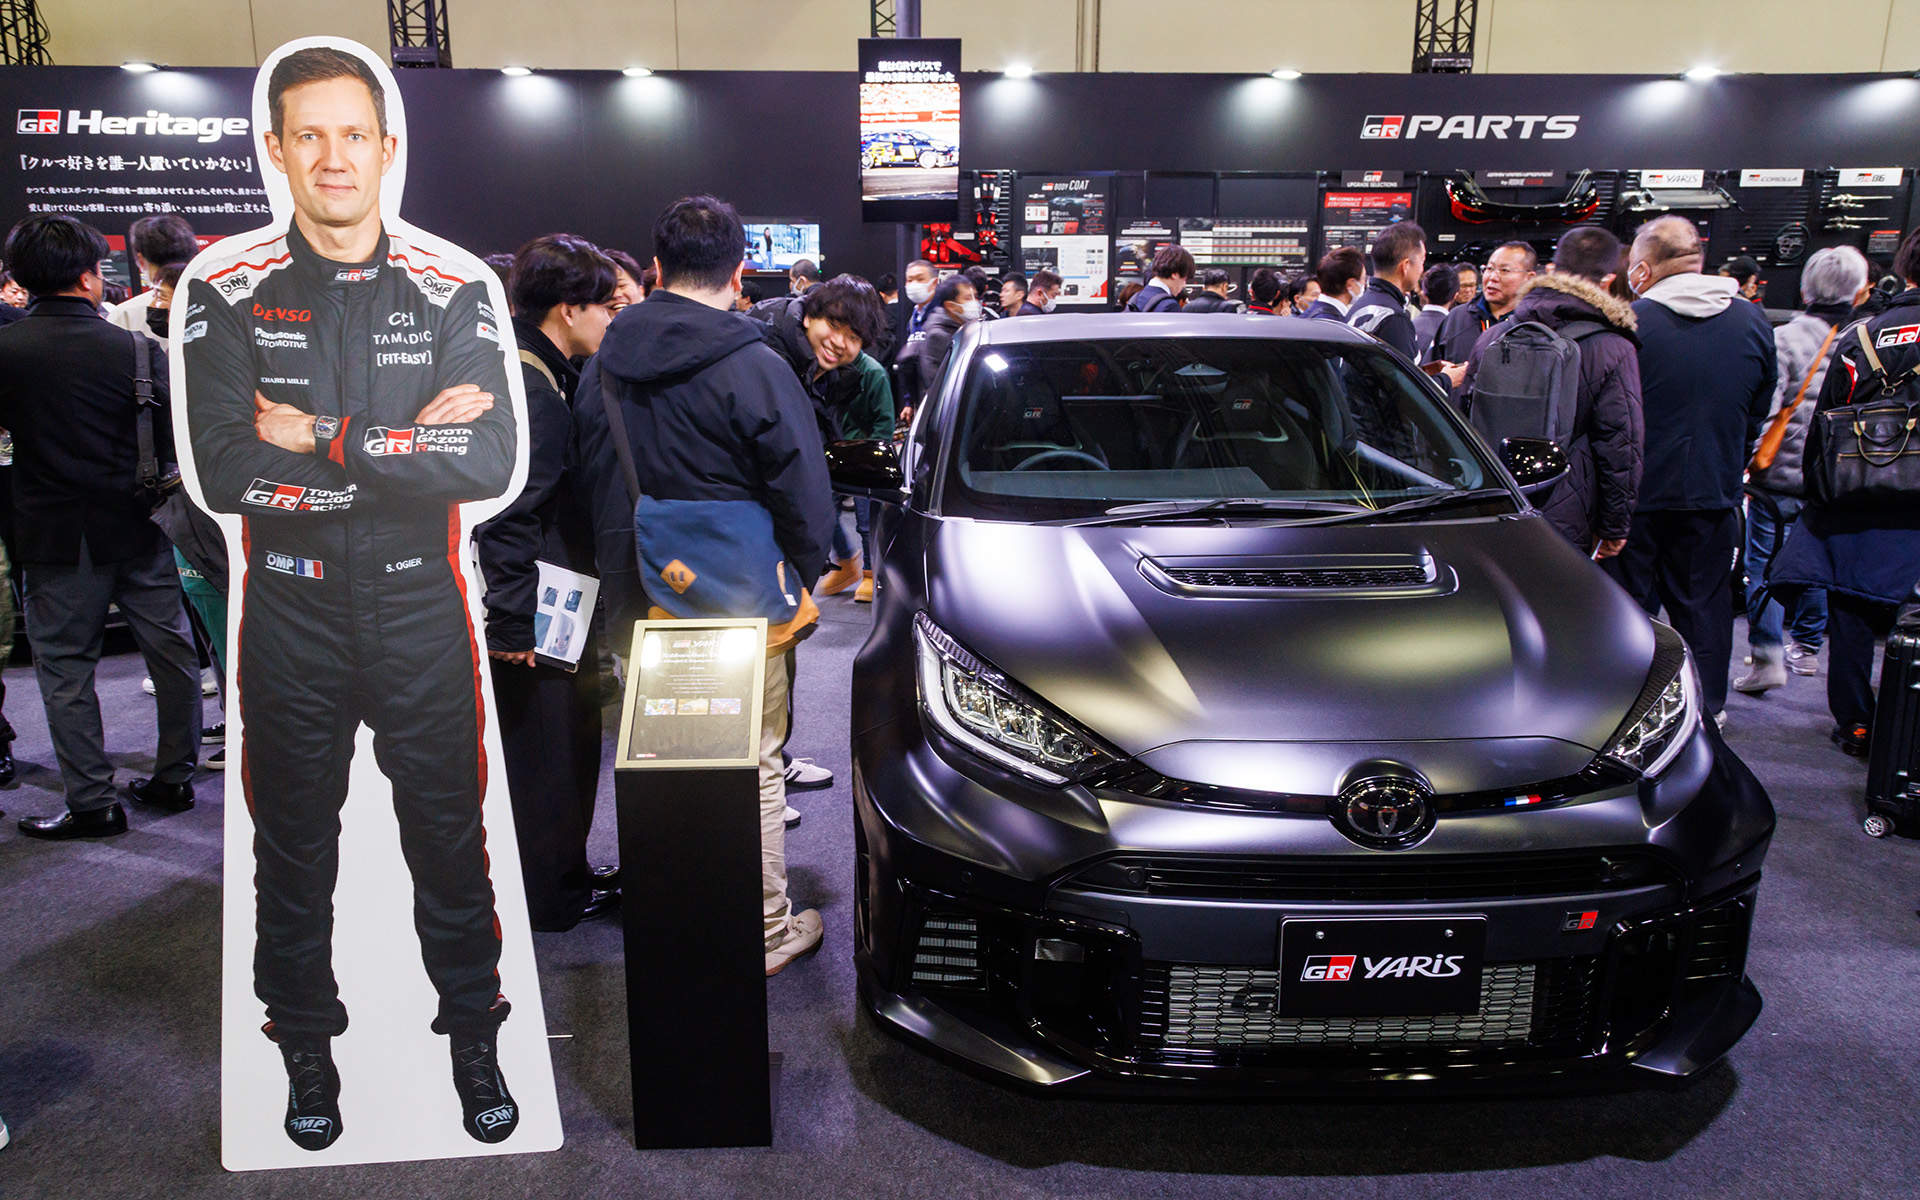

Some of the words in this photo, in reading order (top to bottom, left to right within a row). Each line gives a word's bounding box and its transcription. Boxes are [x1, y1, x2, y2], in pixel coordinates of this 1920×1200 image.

[67, 110, 249, 143] Heritage
[1405, 115, 1581, 139] PARTS
[20, 153, 252, 173] 『クルマ好きを誰一人置いていかない』
[1069, 179, 1090, 191] COAT
[220, 275, 248, 294] OMP
[423, 276, 453, 294] OMP
[252, 303, 312, 322] DENSO
[254, 326, 307, 341] Panasonic
[286, 377, 310, 386] MILLE
[416, 426, 473, 437] TOYOTA
[416, 434, 469, 444] GAZOO
[415, 443, 468, 456] Racing
[308, 483, 358, 498] TOYOTA
[302, 494, 354, 504] GAZOO
[299, 503, 352, 512] Racing
[266, 554, 295, 571] OMP
[386, 562, 395, 573] S.
[396, 557, 423, 571] OGIER
[692, 640, 721, 648] YAR
[1303, 964, 1351, 980] GR
